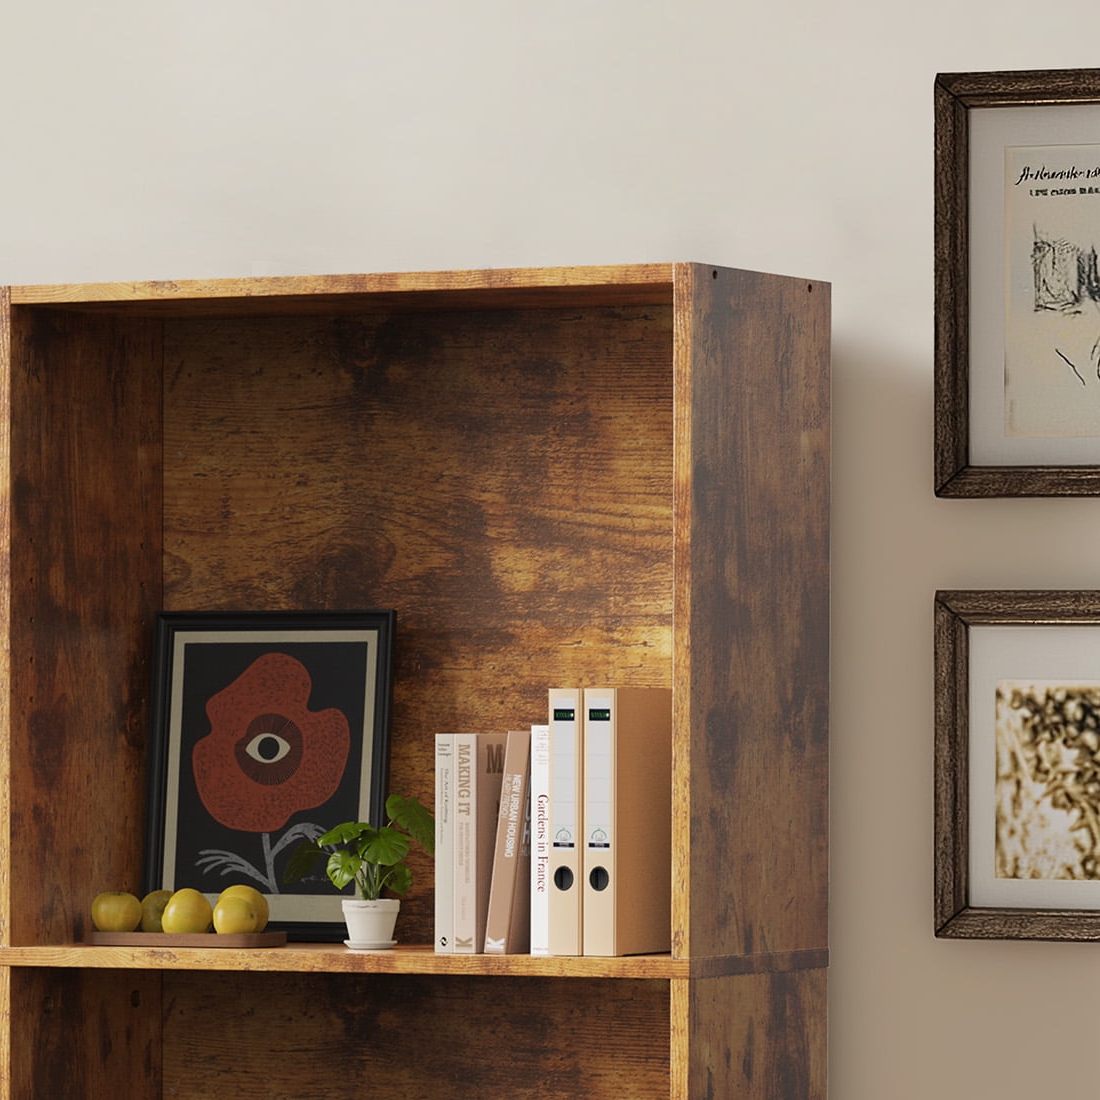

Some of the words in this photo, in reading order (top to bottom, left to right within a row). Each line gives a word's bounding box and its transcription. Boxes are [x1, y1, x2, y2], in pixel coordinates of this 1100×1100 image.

[458, 743, 471, 799] MAKING
[511, 773, 522, 793] NEW
[458, 801, 471, 816] IT
[507, 793, 519, 821] URBAN
[537, 793, 549, 839] Gardens
[503, 821, 517, 858] HOUSING
[537, 842, 549, 853] in
[537, 856, 549, 893] France
